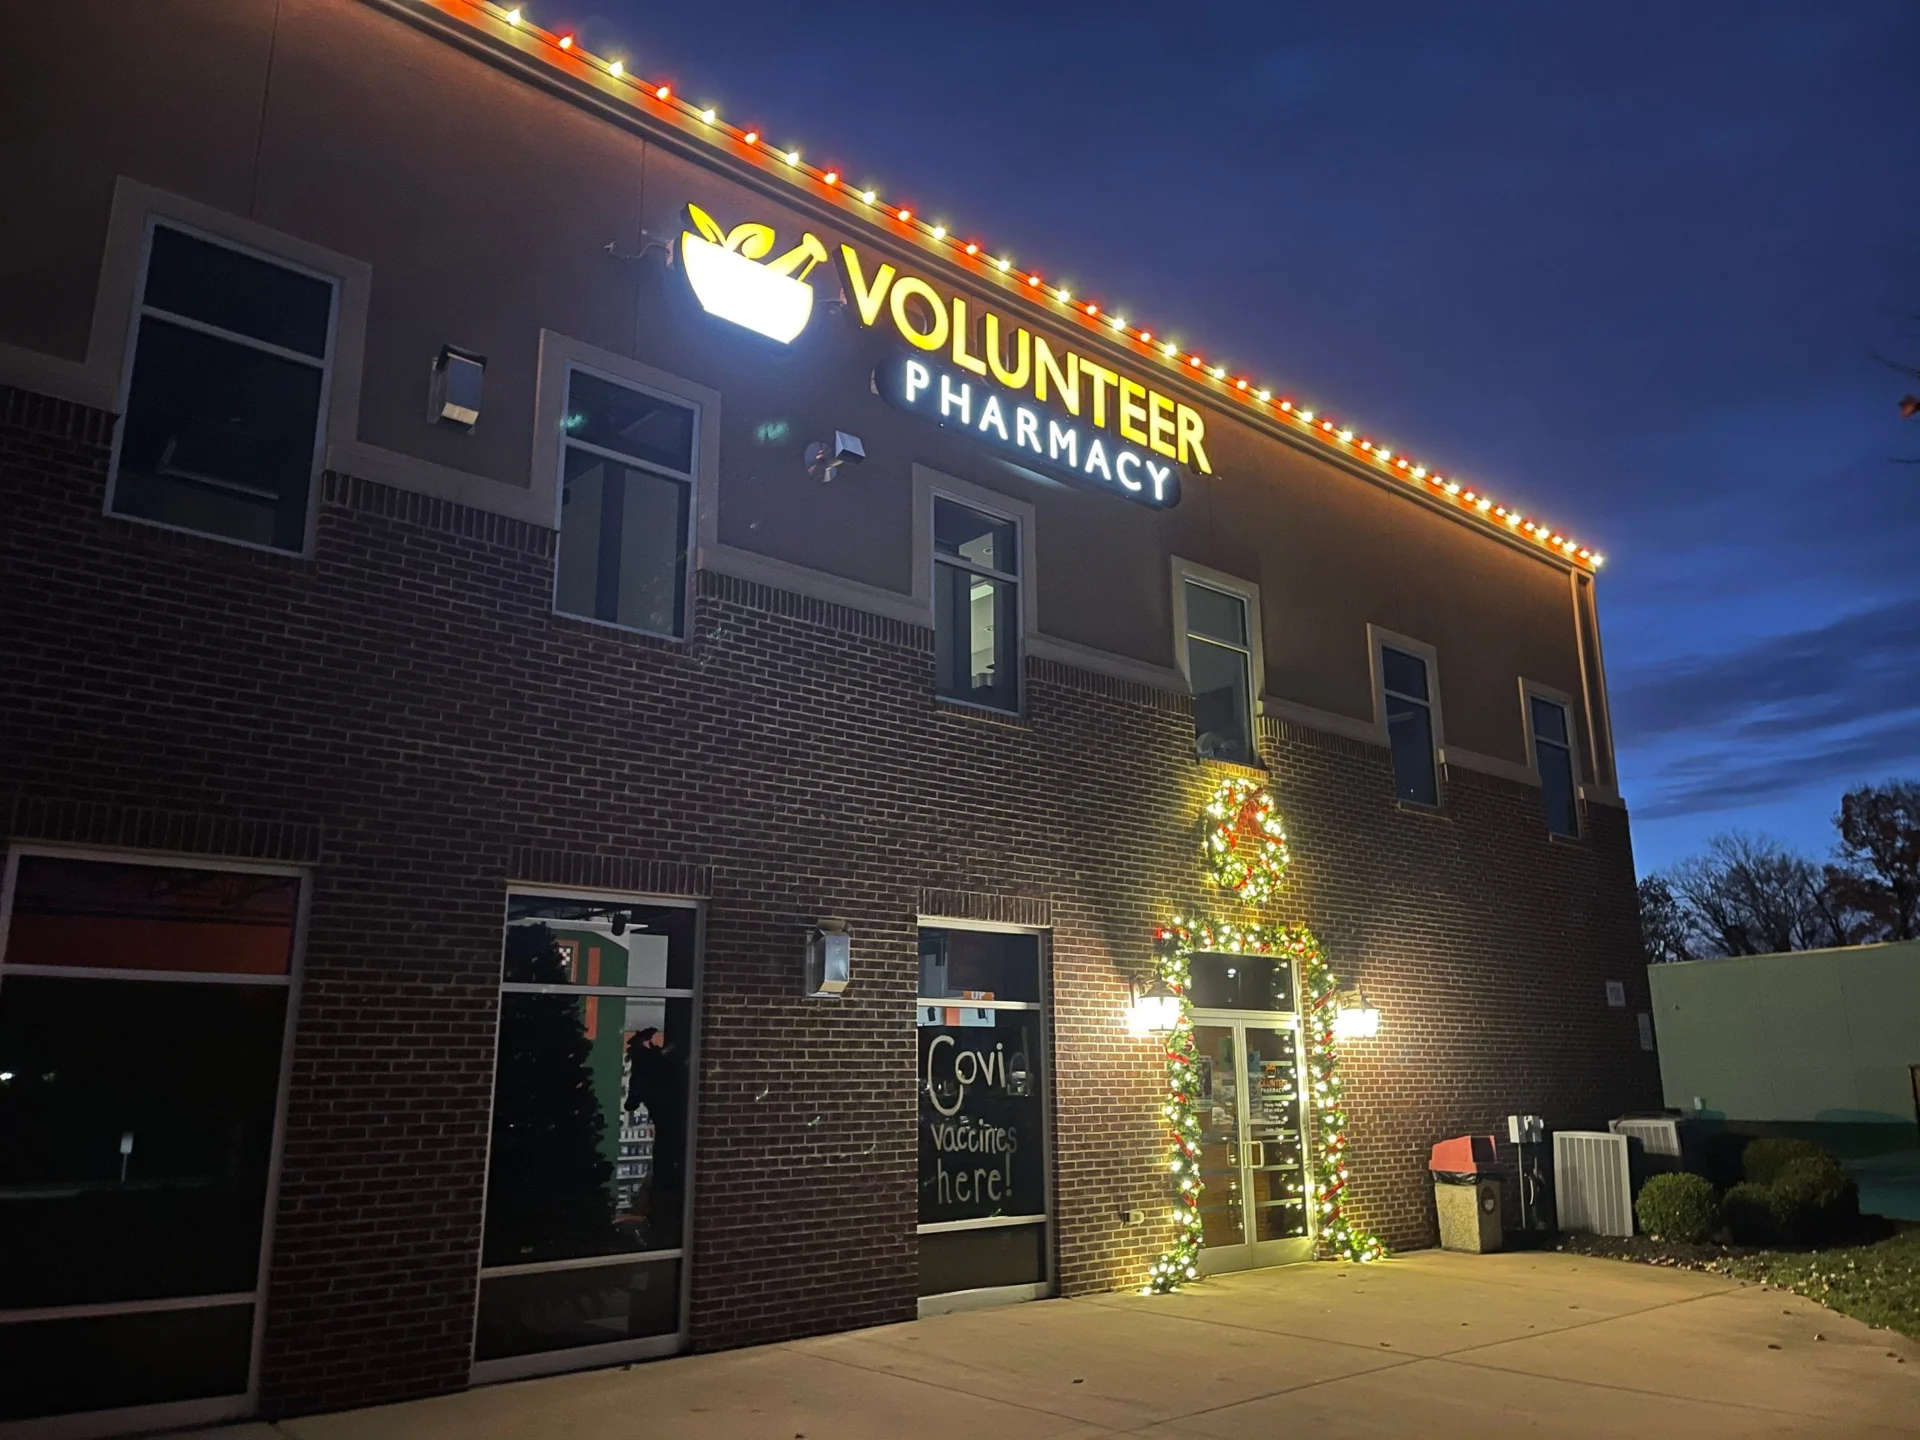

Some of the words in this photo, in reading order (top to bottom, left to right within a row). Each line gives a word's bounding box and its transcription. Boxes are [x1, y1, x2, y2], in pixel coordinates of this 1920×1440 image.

[840, 243, 1213, 475] VOLUNTEER
[905, 359, 1171, 501] PHARMACY
[930, 1118, 1018, 1154] vaccines
[936, 1151, 1013, 1204] here!
